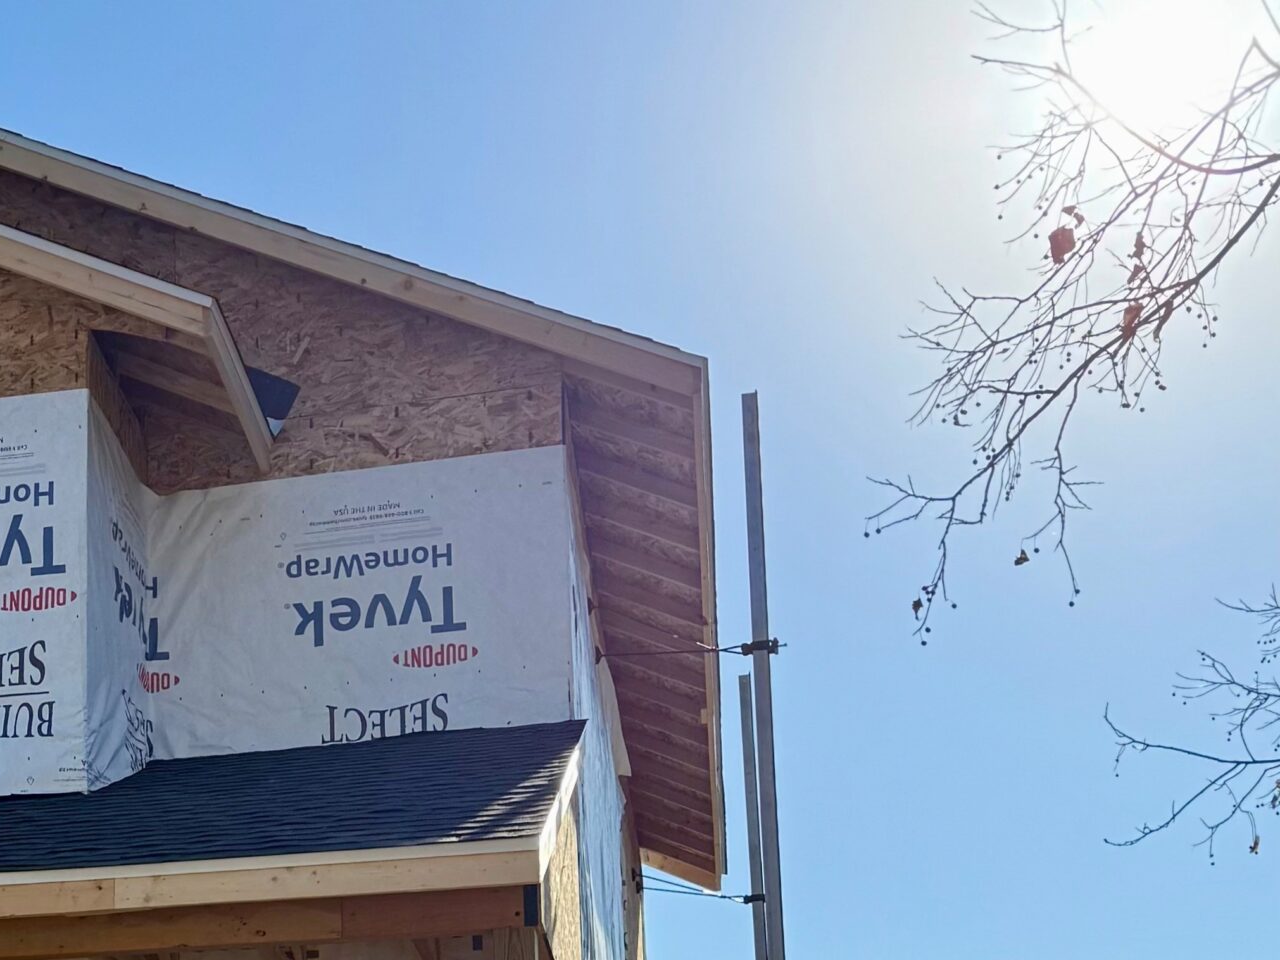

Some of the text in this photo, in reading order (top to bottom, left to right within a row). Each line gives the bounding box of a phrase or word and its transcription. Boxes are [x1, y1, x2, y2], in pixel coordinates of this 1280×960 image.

[332, 508, 349, 516] USA
[350, 506, 365, 514] THE
[378, 502, 401, 510] MADE
[286, 543, 452, 579] HomeWrap
[1, 587, 67, 612] DUPONT
[292, 576, 467, 648] Tyvek
[404, 643, 468, 668] DUPONT
[322, 693, 449, 744] SELECT
